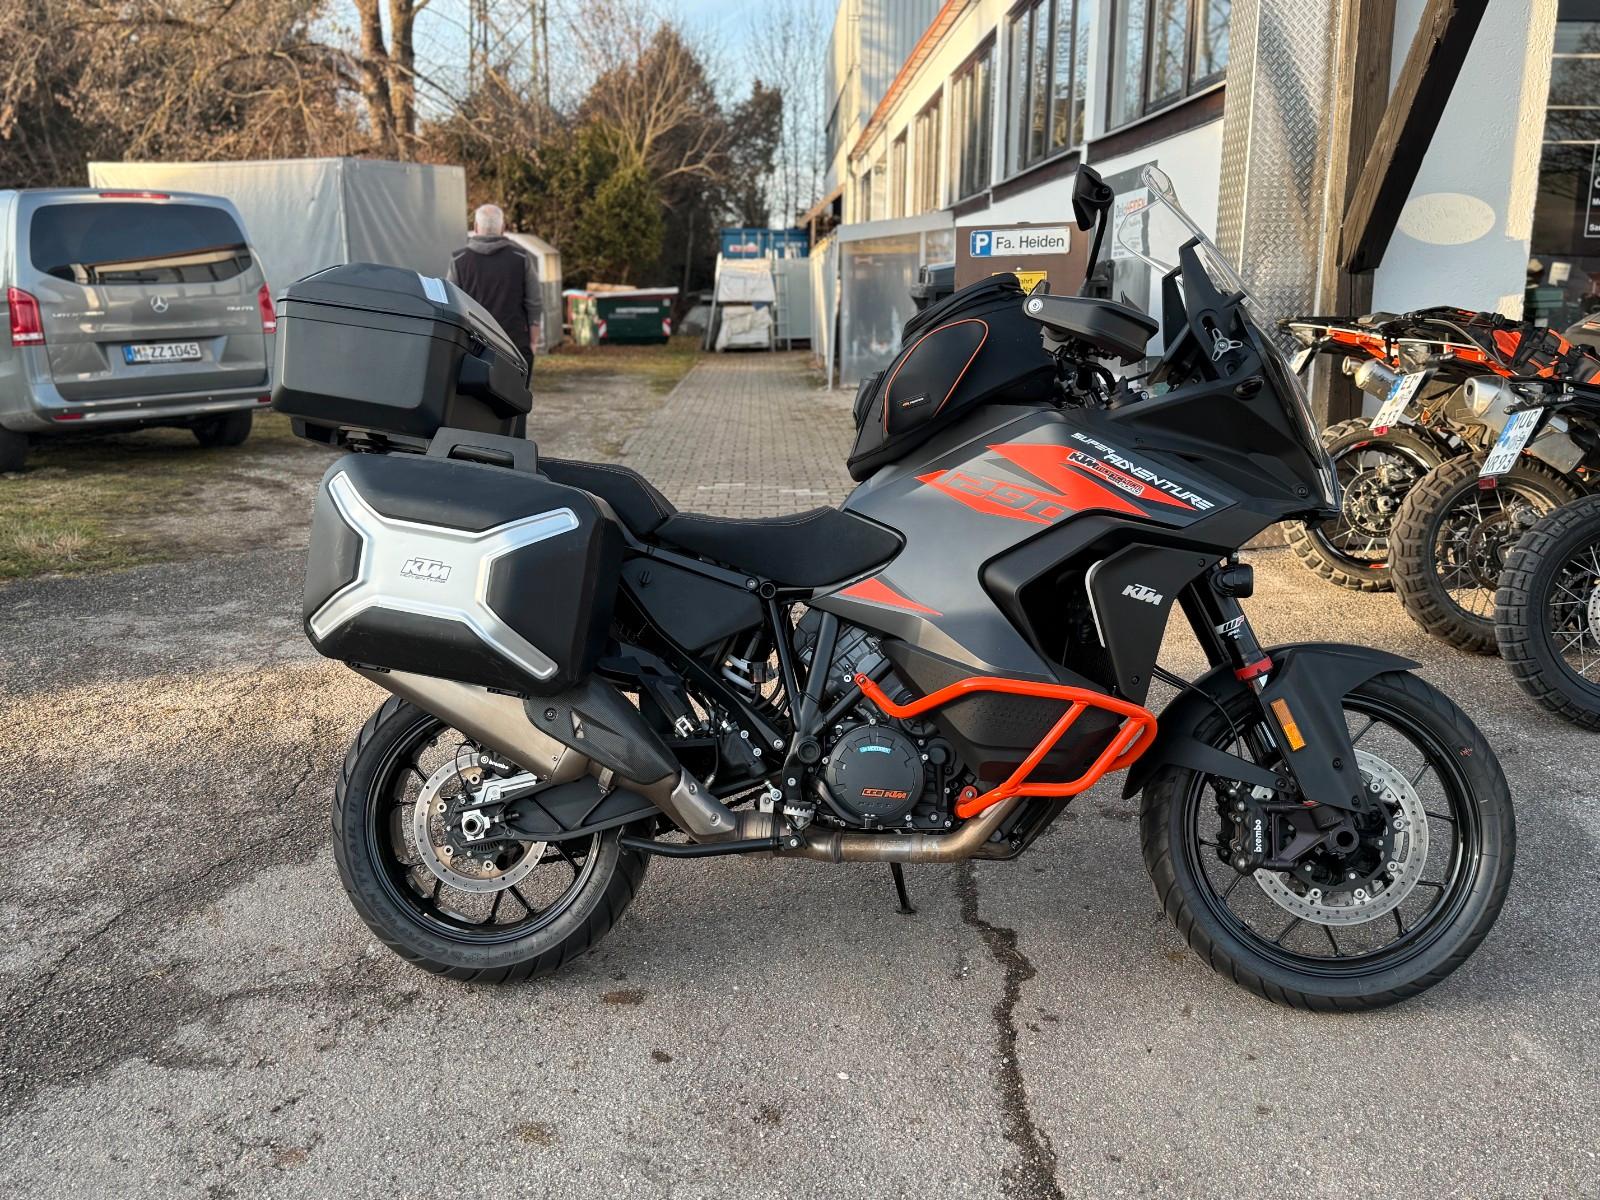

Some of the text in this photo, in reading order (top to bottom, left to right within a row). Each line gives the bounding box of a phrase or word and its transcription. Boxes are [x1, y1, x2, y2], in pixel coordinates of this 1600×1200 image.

[996, 236, 1015, 249] Fa.
[1019, 235, 1065, 249] Heiden
[1071, 432, 1116, 455] SUPER
[1104, 453, 1215, 510] ADVENTURE
[400, 557, 452, 580] KTM
[1121, 583, 1163, 605] KTM
[1253, 819, 1262, 853] brembo
